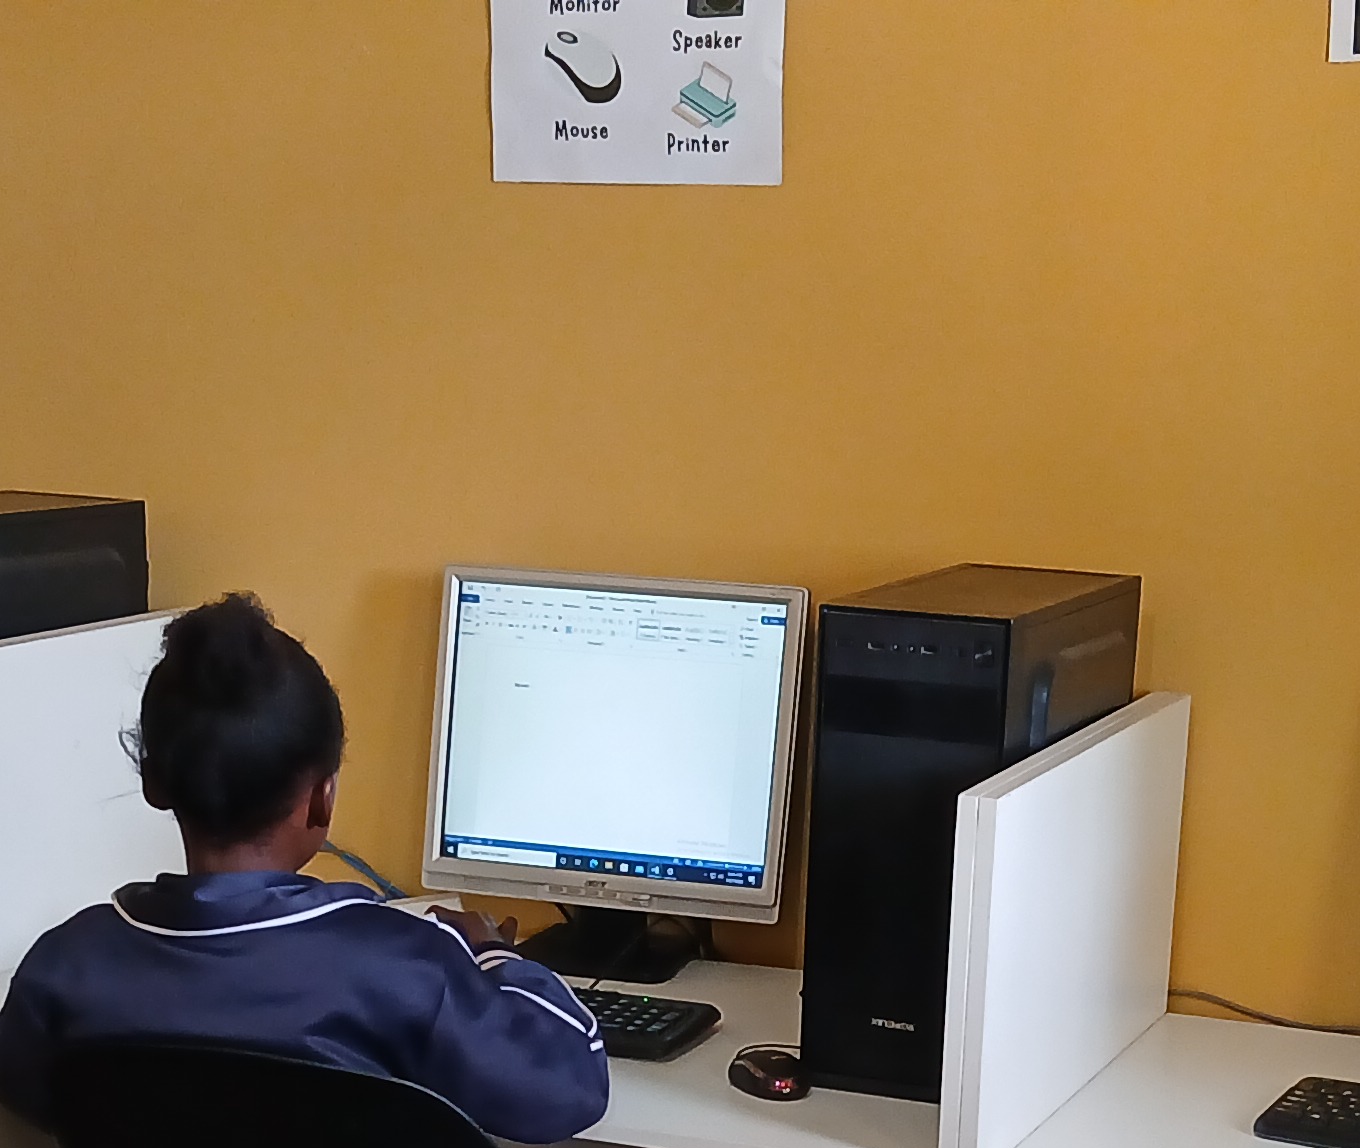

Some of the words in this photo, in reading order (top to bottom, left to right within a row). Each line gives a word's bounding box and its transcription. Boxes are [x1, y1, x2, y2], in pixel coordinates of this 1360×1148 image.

[549, 0, 620, 15] Monitor
[672, 29, 743, 54] Speaker
[554, 119, 609, 142] Mouse
[667, 132, 730, 155] Printer
